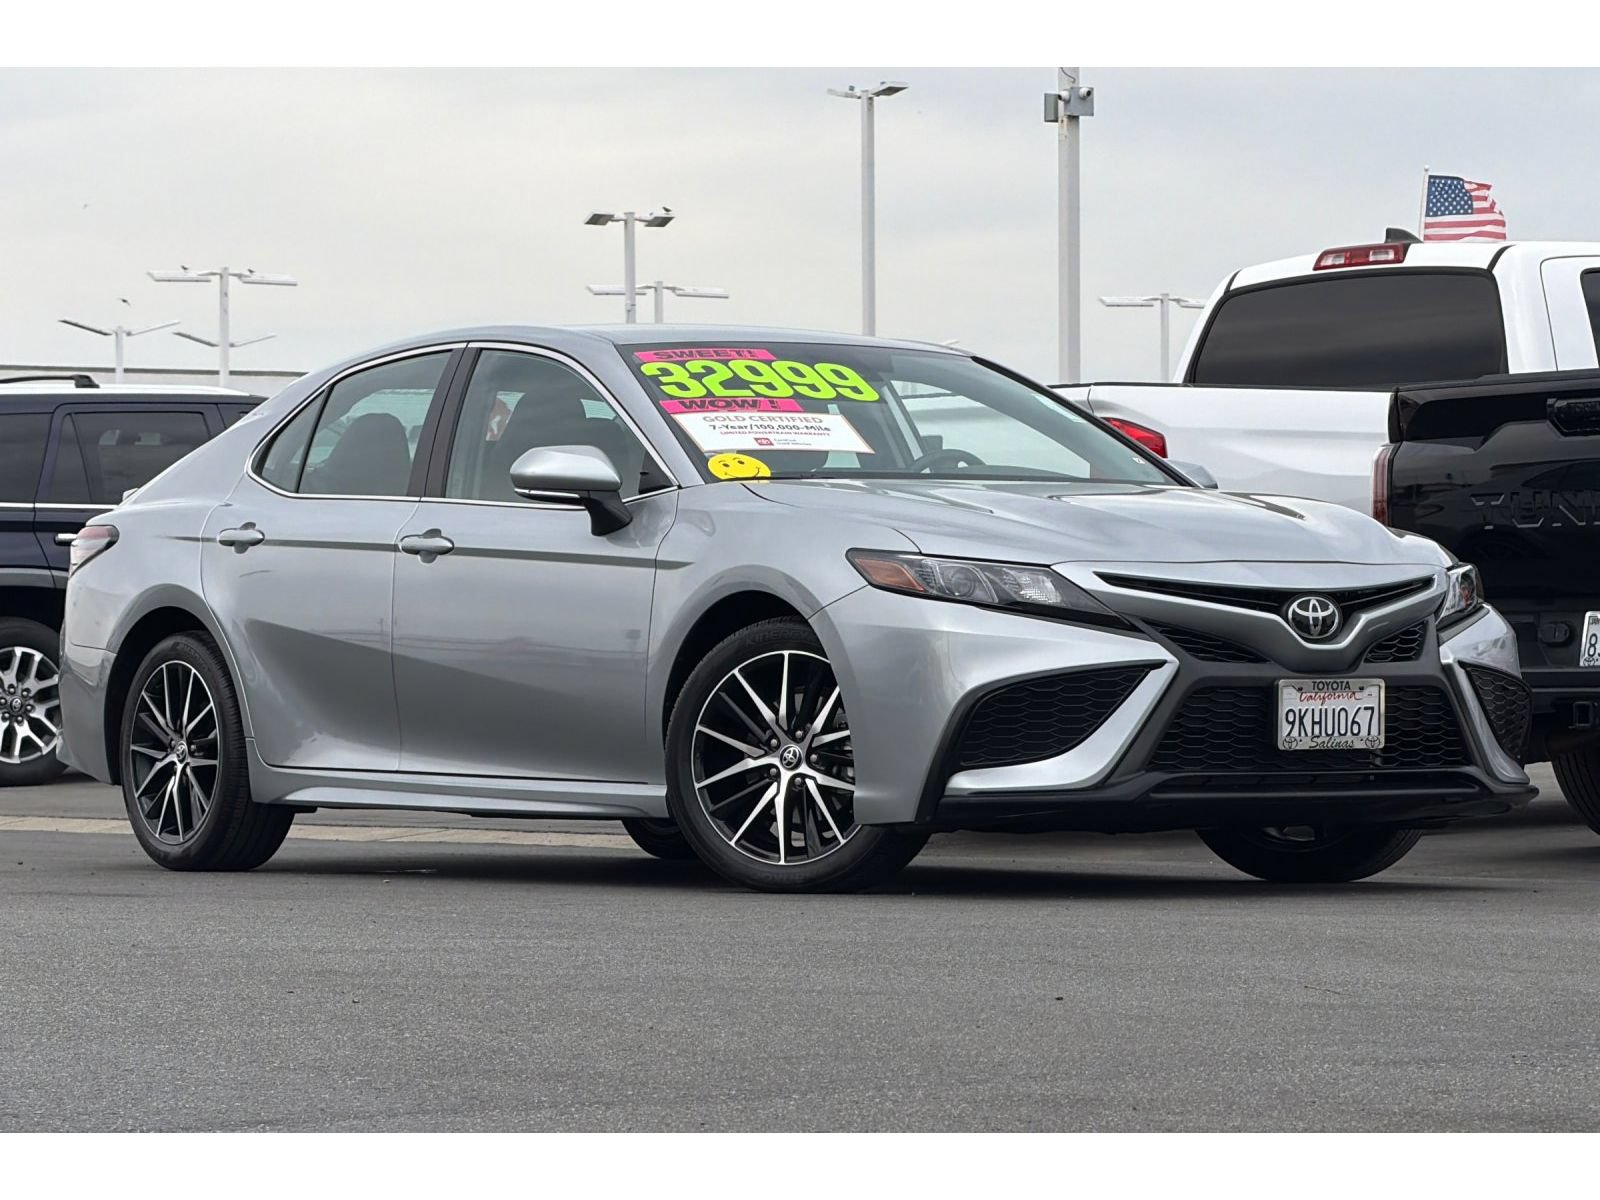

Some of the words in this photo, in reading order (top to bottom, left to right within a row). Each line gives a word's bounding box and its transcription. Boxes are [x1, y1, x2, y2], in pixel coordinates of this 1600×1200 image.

[653, 349, 757, 360] SWEET!
[640, 359, 880, 402] 32999
[702, 415, 747, 423] GOLD
[748, 415, 823, 424] CERTIFIED
[708, 423, 832, 432] 7-Year/100,000-Mile
[1588, 633, 1600, 658] 8
[1311, 680, 1351, 692] TOYOTA
[1299, 690, 1363, 706] California
[1284, 706, 1376, 738] 9KHU067
[1309, 736, 1355, 750] Salinas
